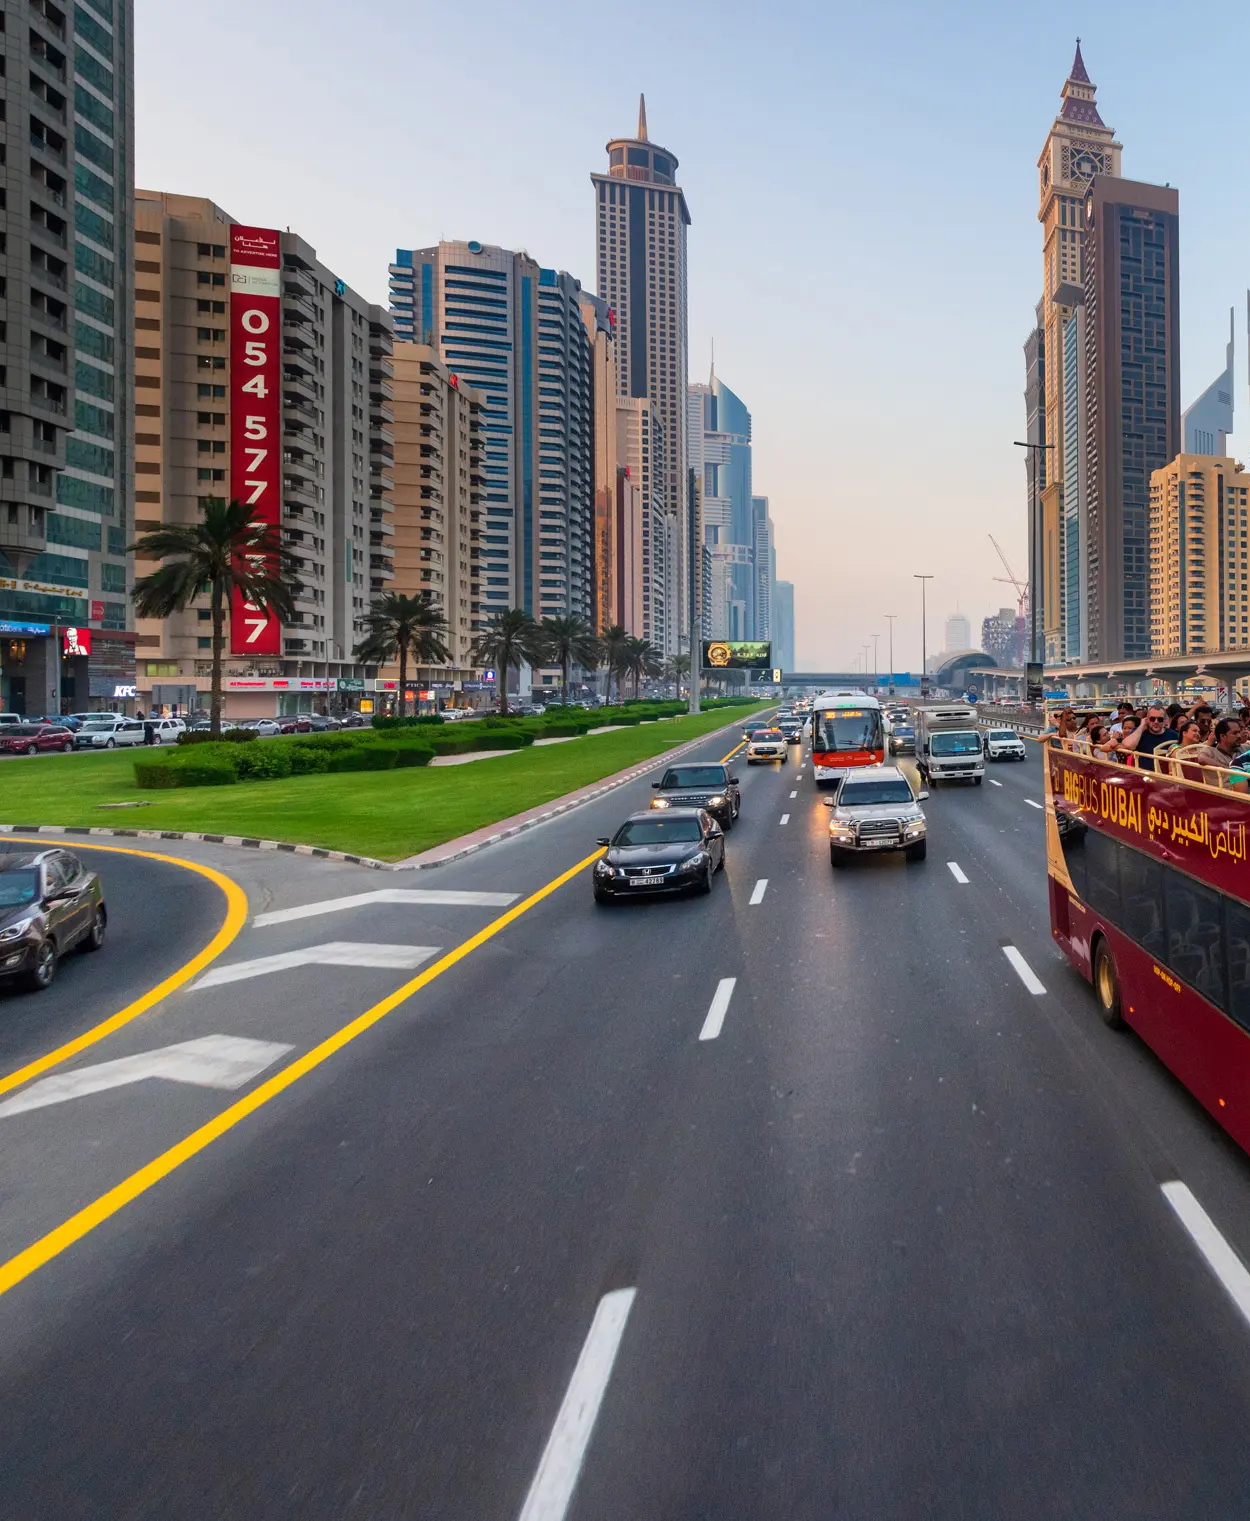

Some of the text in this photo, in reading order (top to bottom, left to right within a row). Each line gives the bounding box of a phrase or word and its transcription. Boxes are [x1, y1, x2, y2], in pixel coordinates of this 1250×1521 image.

[241, 309, 270, 399] 054
[113, 685, 136, 697] KFC
[1100, 782, 1142, 833] DUBAI
[1147, 805, 1247, 864] الباص الكبير دبي
